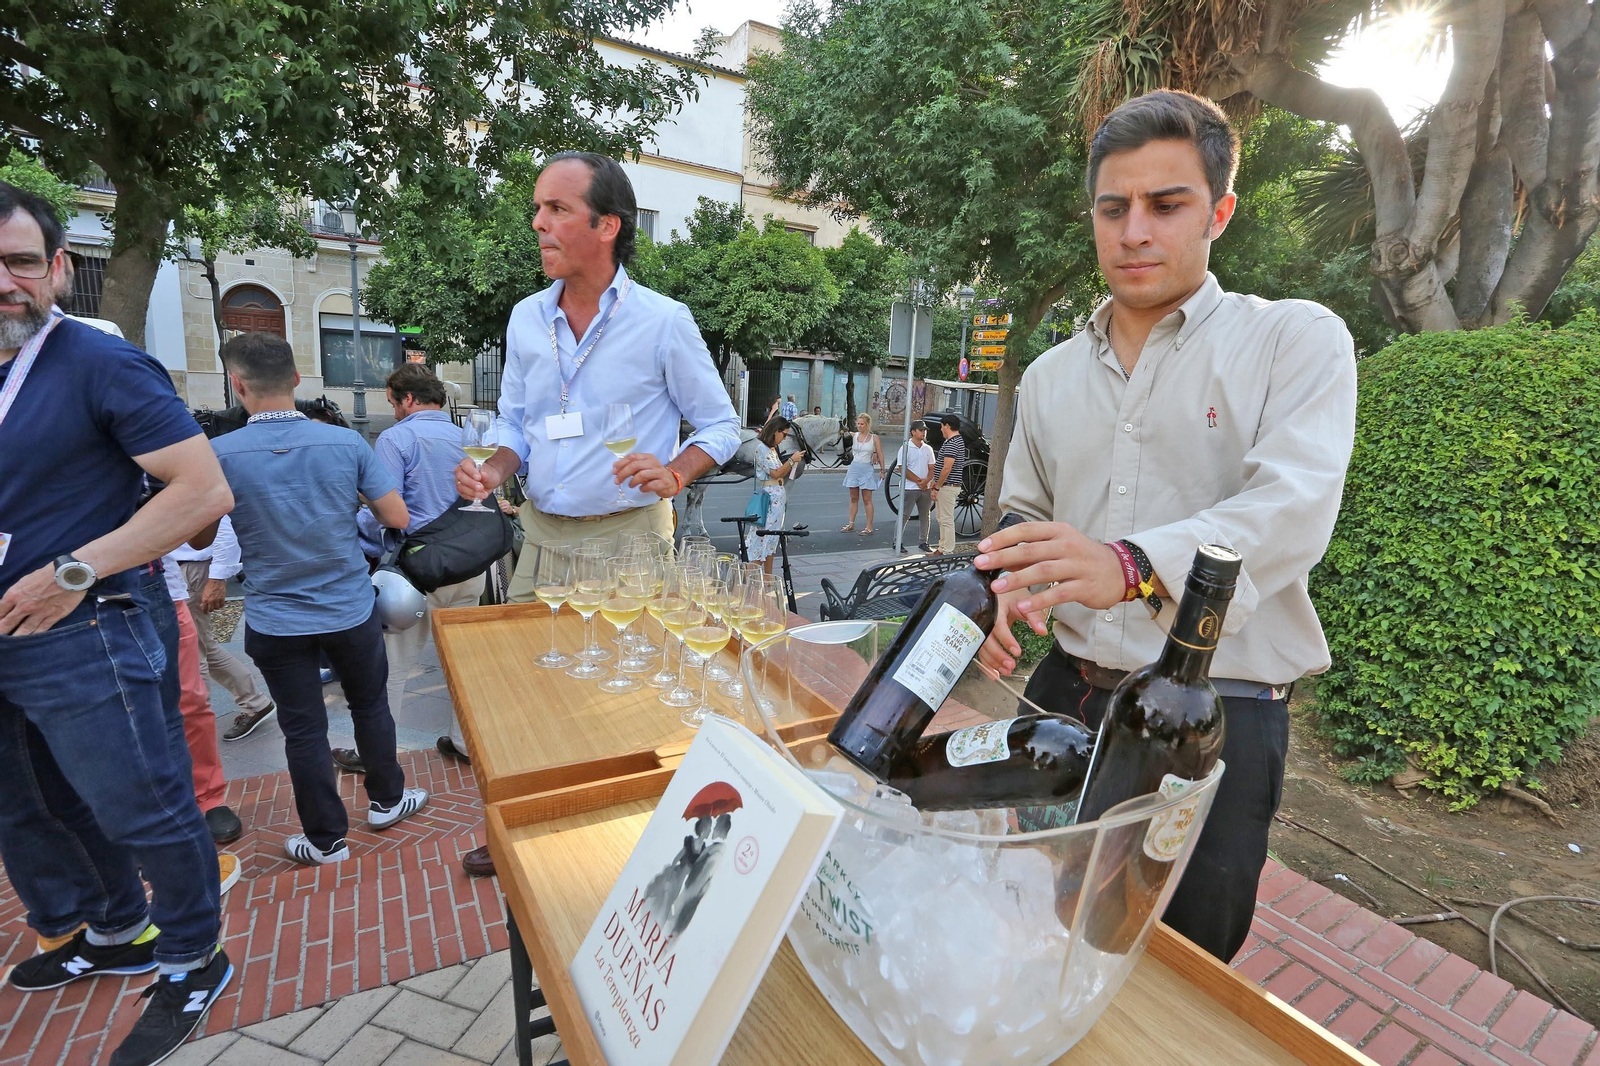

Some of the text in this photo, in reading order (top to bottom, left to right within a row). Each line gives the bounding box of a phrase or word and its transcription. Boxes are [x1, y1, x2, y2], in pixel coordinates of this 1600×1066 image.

[944, 636, 962, 654] RAMA
[816, 874, 874, 946] TWIST
[826, 850, 861, 900] ARKLY
[603, 909, 666, 1032] DUEÑAS
[624, 885, 676, 988] MARÍA
[816, 922, 860, 956] APERITIF
[594, 945, 642, 1049] La Templanza
